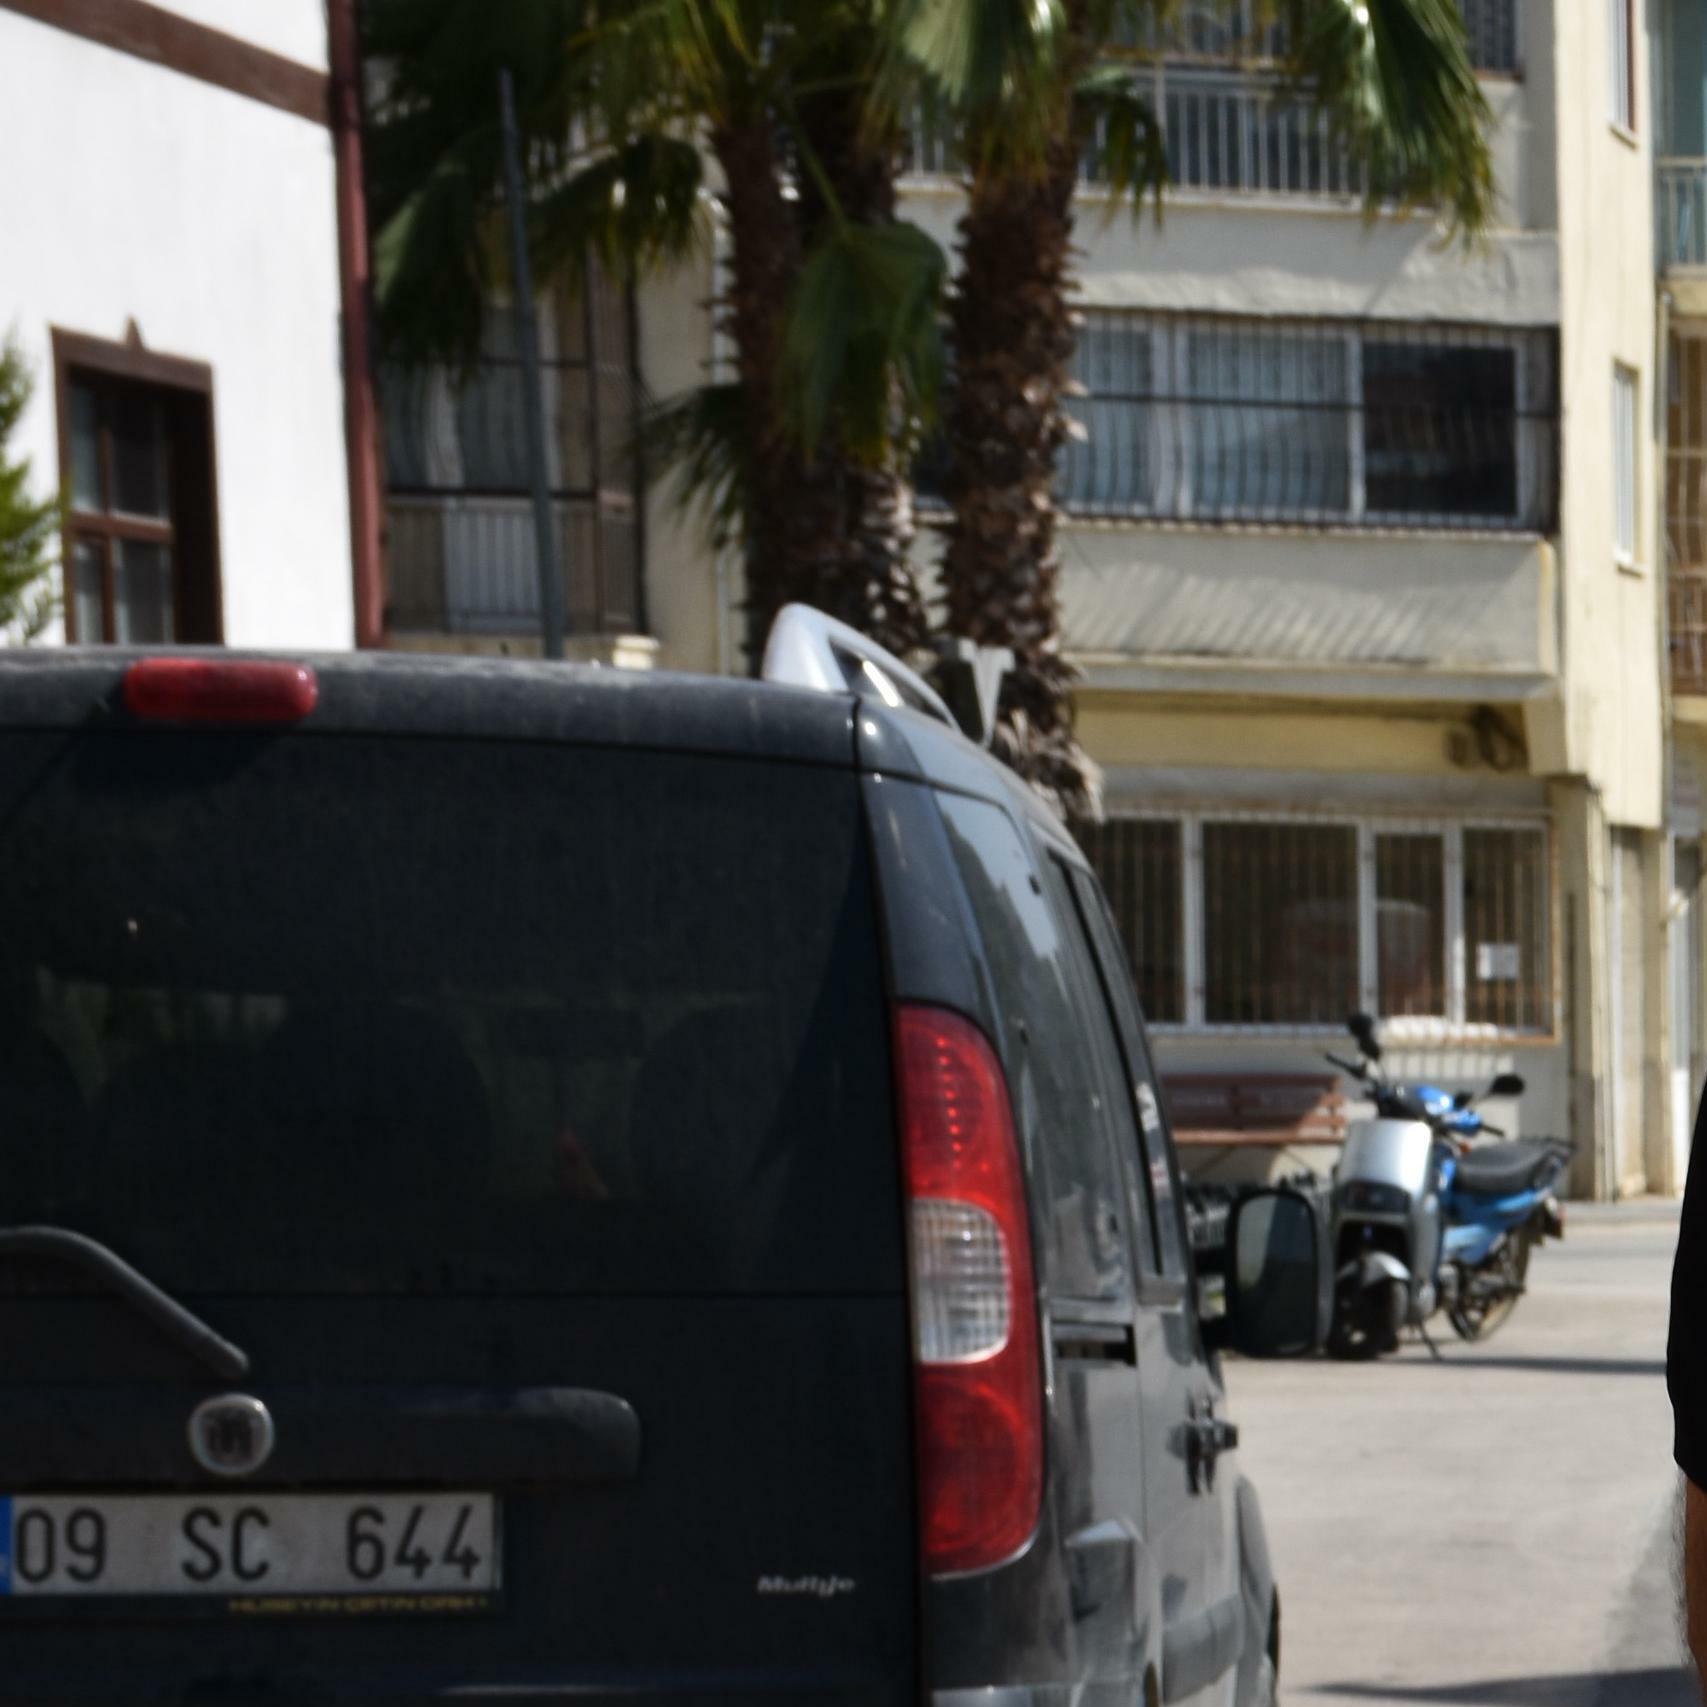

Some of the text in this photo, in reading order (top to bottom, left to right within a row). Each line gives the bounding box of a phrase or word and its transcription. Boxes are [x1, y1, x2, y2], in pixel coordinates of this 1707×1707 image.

[15, 1504, 482, 1583] 09 SC 644
